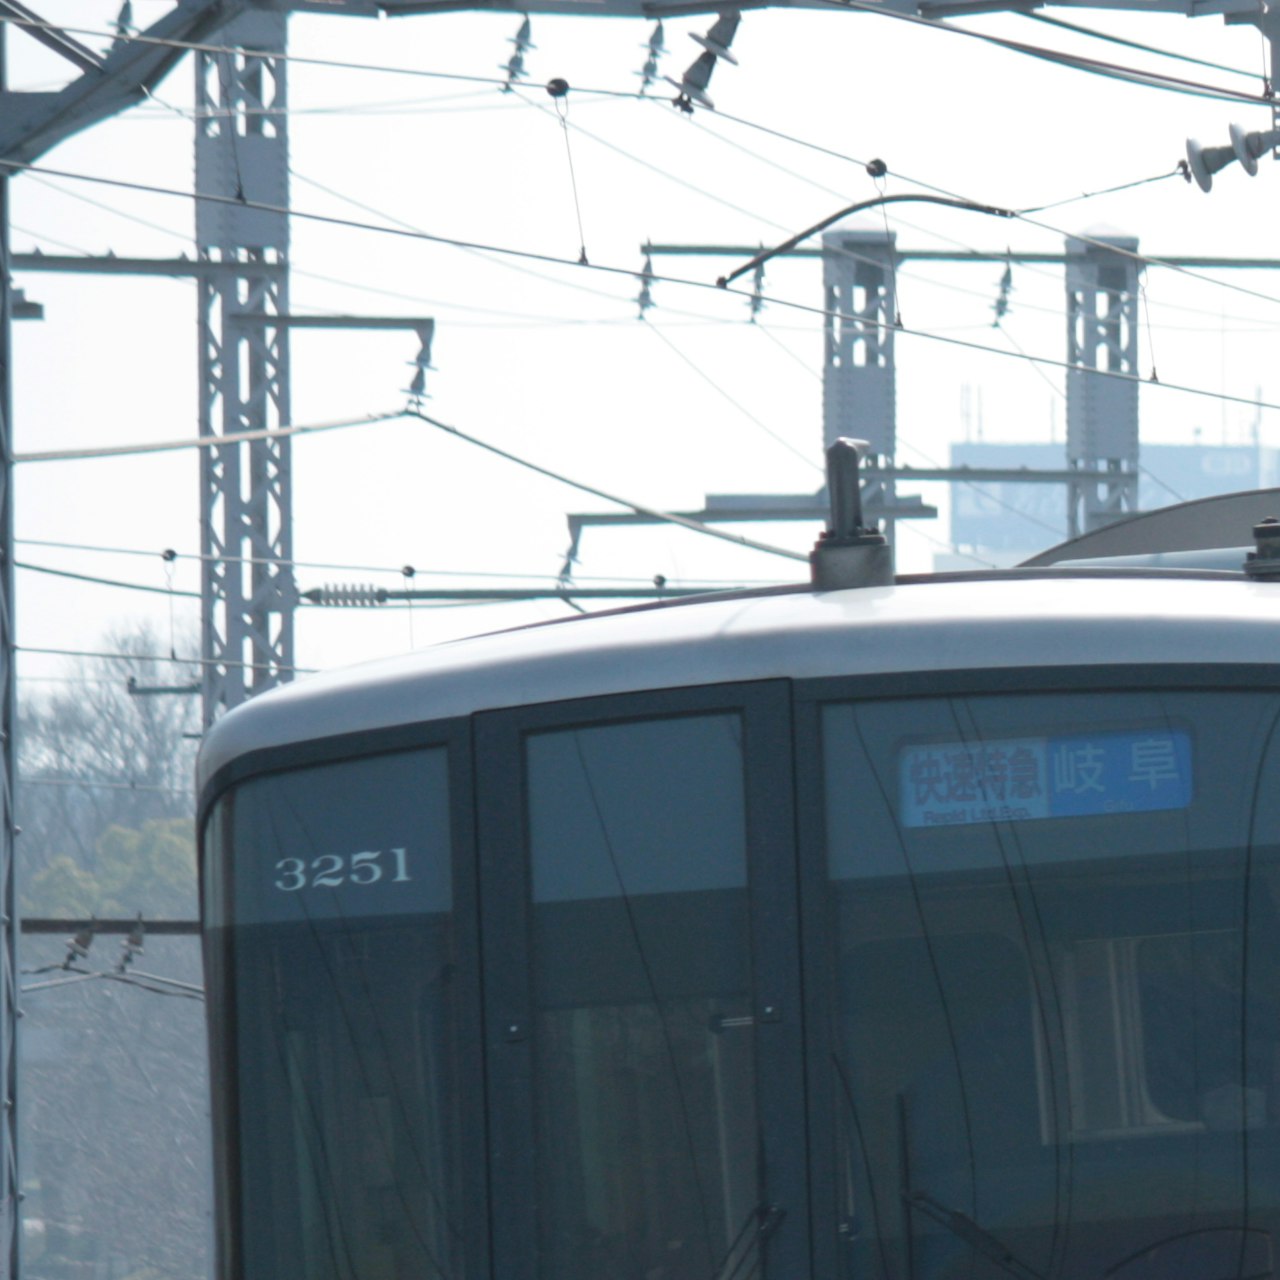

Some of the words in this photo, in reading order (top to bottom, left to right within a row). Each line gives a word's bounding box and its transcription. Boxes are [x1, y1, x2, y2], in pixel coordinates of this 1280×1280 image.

[908, 746, 1042, 806] 快速特急
[1051, 738, 1180, 793] 岐阜
[274, 848, 412, 892] 3251
